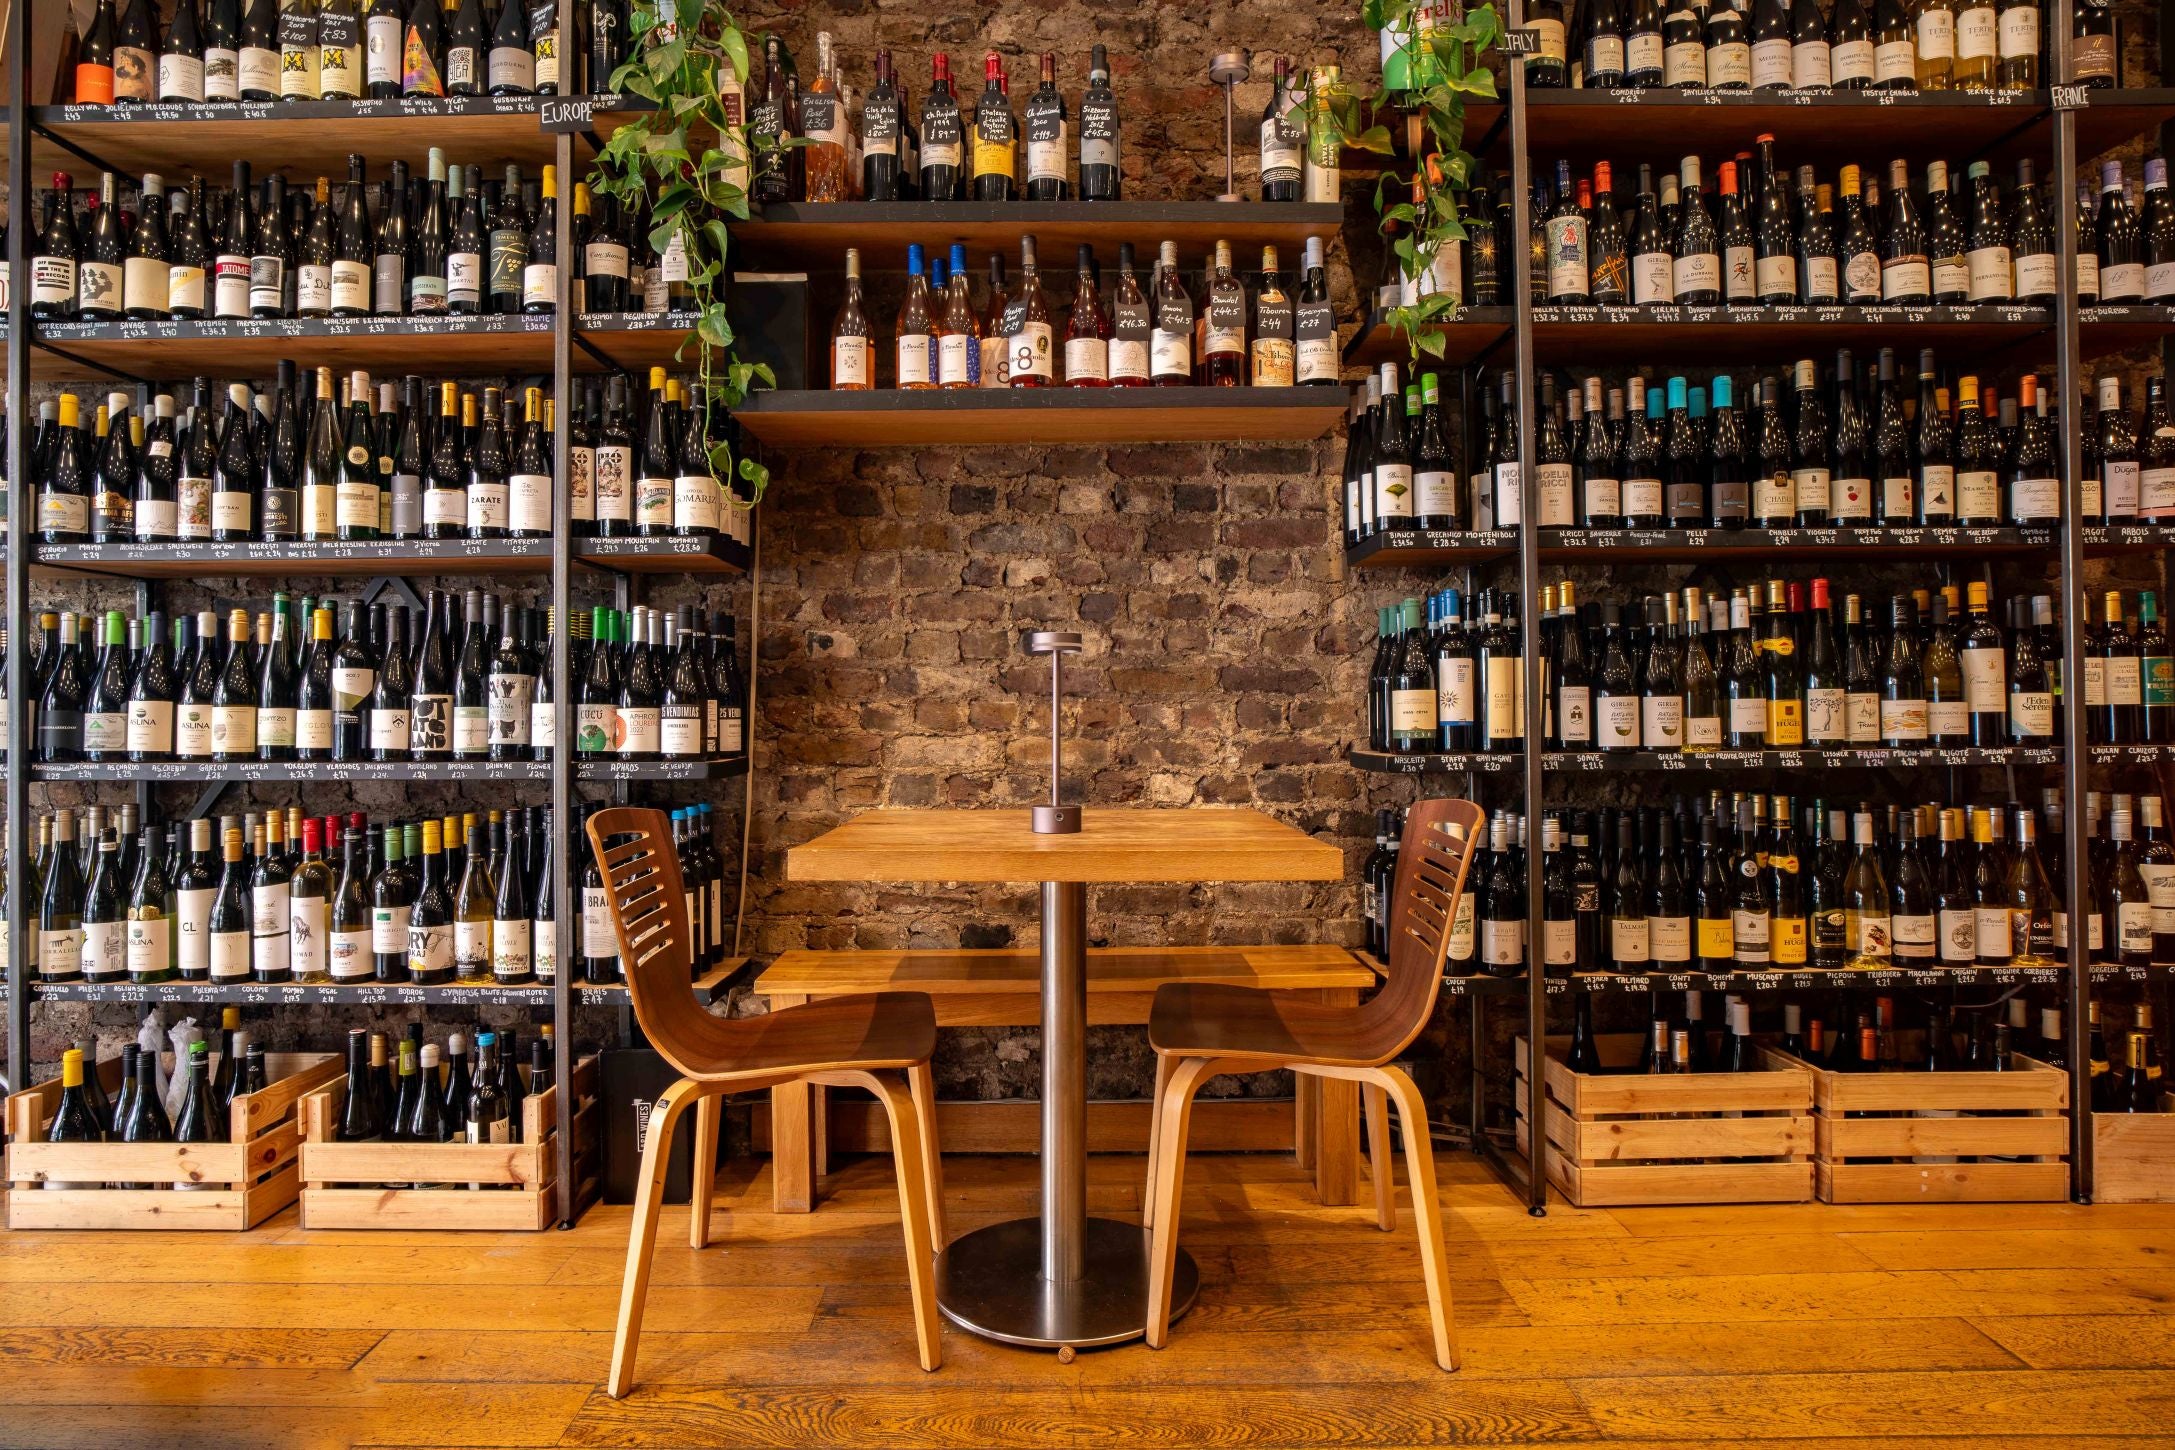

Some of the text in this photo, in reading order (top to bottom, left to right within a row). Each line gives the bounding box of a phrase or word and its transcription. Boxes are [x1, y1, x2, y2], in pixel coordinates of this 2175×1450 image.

[320, 28, 348, 40] £83
[2052, 87, 2088, 106] FRANCE
[448, 105, 463, 113] £41
[542, 102, 592, 124] EUROPE
[807, 118, 828, 128] £36
[755, 121, 777, 135] £25
[1282, 129, 1300, 138] £55
[1213, 307, 1240, 316] £44.5
[1612, 314, 1628, 322] £34
[1119, 320, 1146, 328] £16.50
[1260, 320, 1281, 330] £44
[1301, 319, 1320, 328] £27
[1541, 480, 1566, 488] RICCI
[1599, 538, 1615, 547] £32
[1775, 537, 1790, 545] £29
[1939, 536, 1954, 544] £34
[181, 722, 210, 730] ASLINA
[611, 763, 639, 771] APHROS
[246, 771, 260, 779] £24
[290, 770, 313, 779] £26.5
[333, 771, 348, 779] £24
[413, 770, 426, 778] £24
[1756, 981, 1776, 989] £20.5
